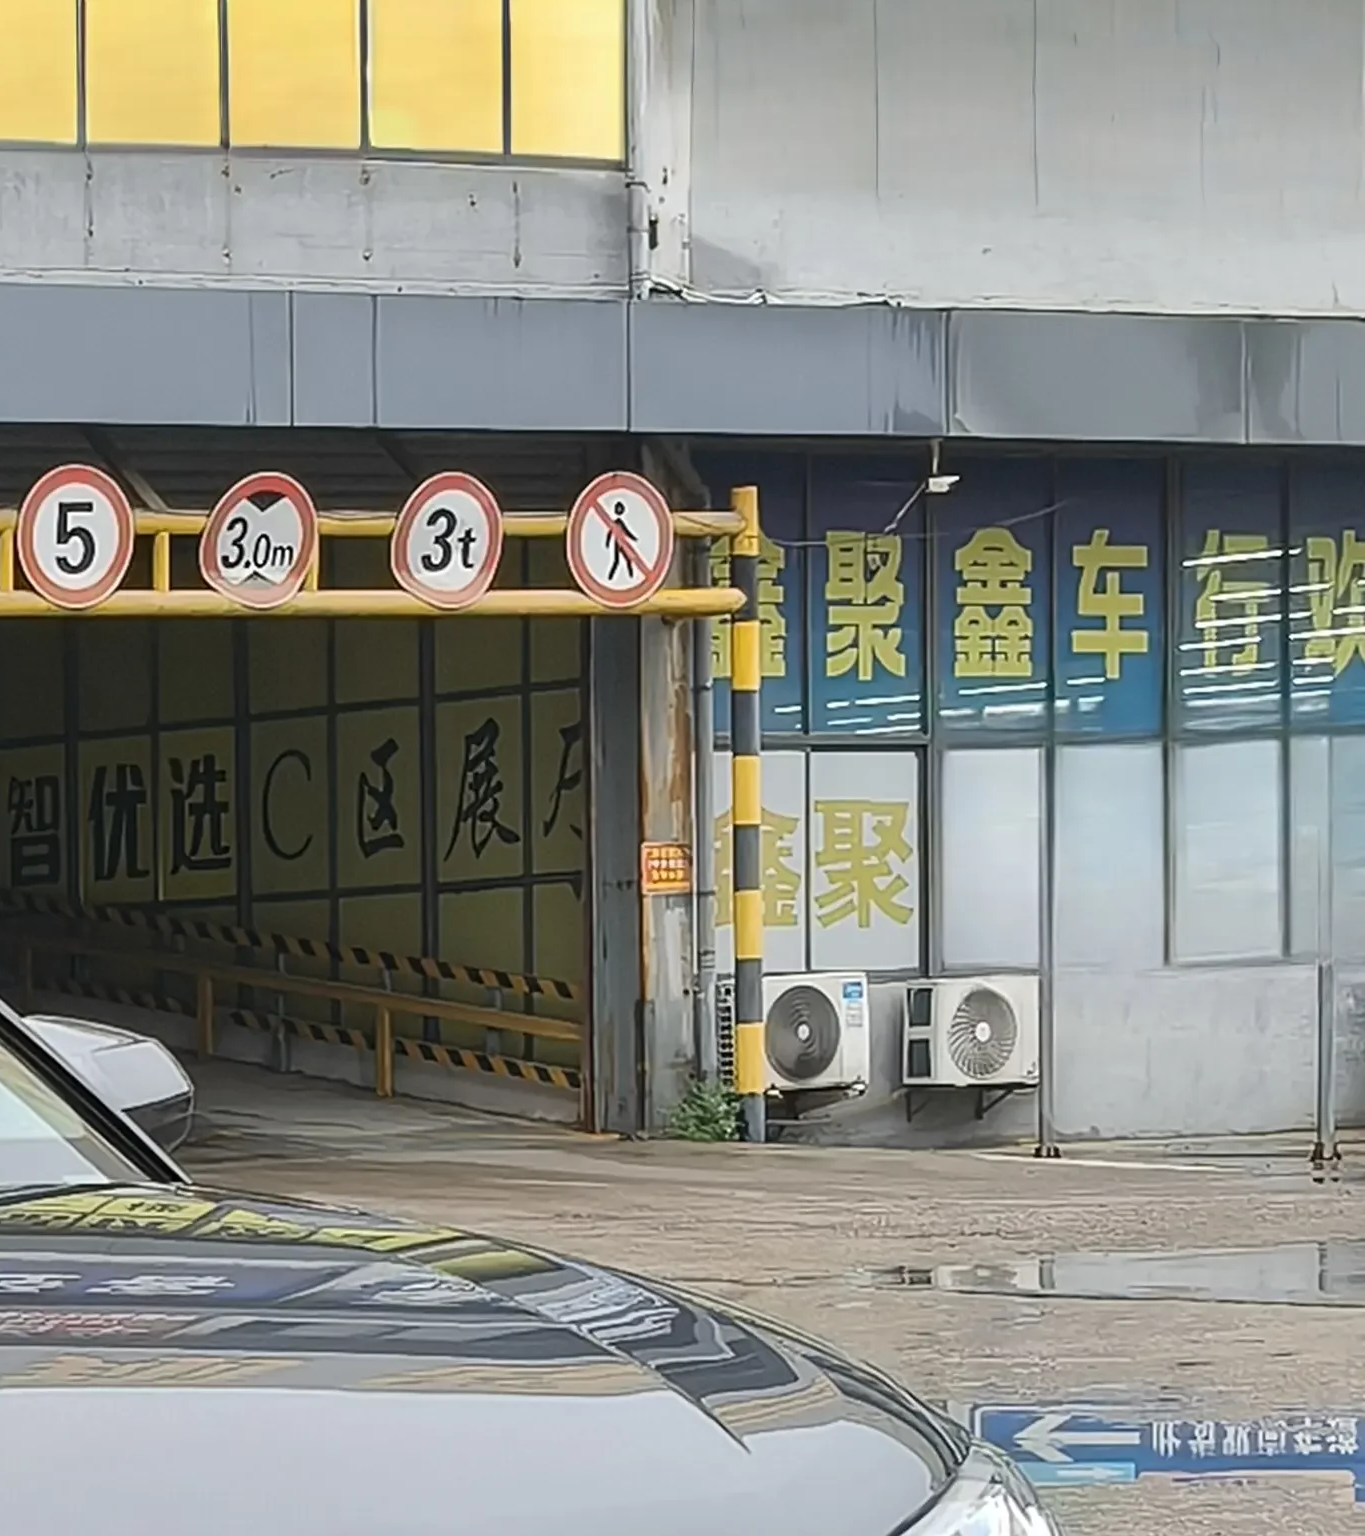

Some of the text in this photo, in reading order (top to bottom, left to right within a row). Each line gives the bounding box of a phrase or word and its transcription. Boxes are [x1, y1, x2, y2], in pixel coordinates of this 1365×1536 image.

[56, 501, 97, 575] 5
[220, 516, 294, 569] 3.0m
[421, 508, 477, 572] 3t
